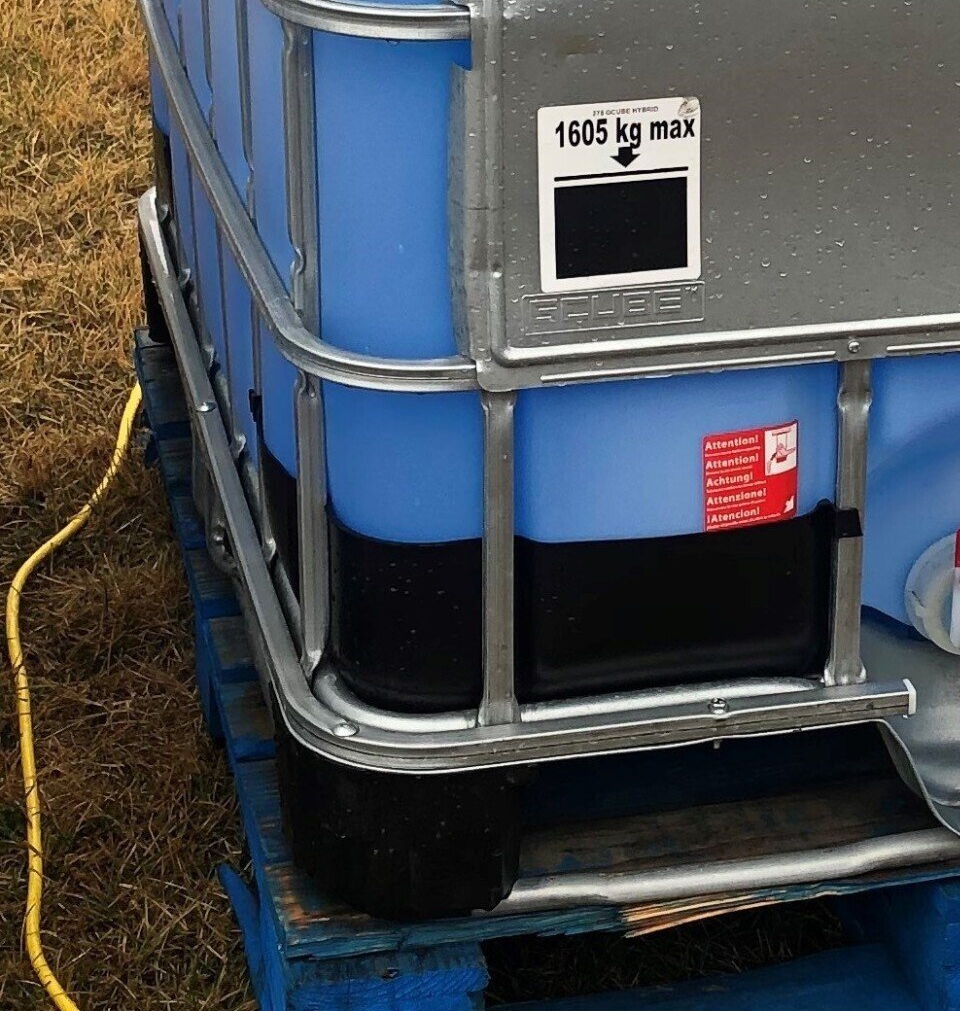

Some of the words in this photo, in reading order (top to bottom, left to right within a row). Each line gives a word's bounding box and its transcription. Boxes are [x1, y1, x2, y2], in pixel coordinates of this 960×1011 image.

[555, 118, 608, 148] 1605
[616, 117, 641, 149] kg
[650, 118, 695, 140] max
[704, 434, 759, 451] Attention!
[705, 453, 759, 470] Attention!
[706, 471, 753, 488] Achtung!
[706, 488, 767, 506] Attenzione!
